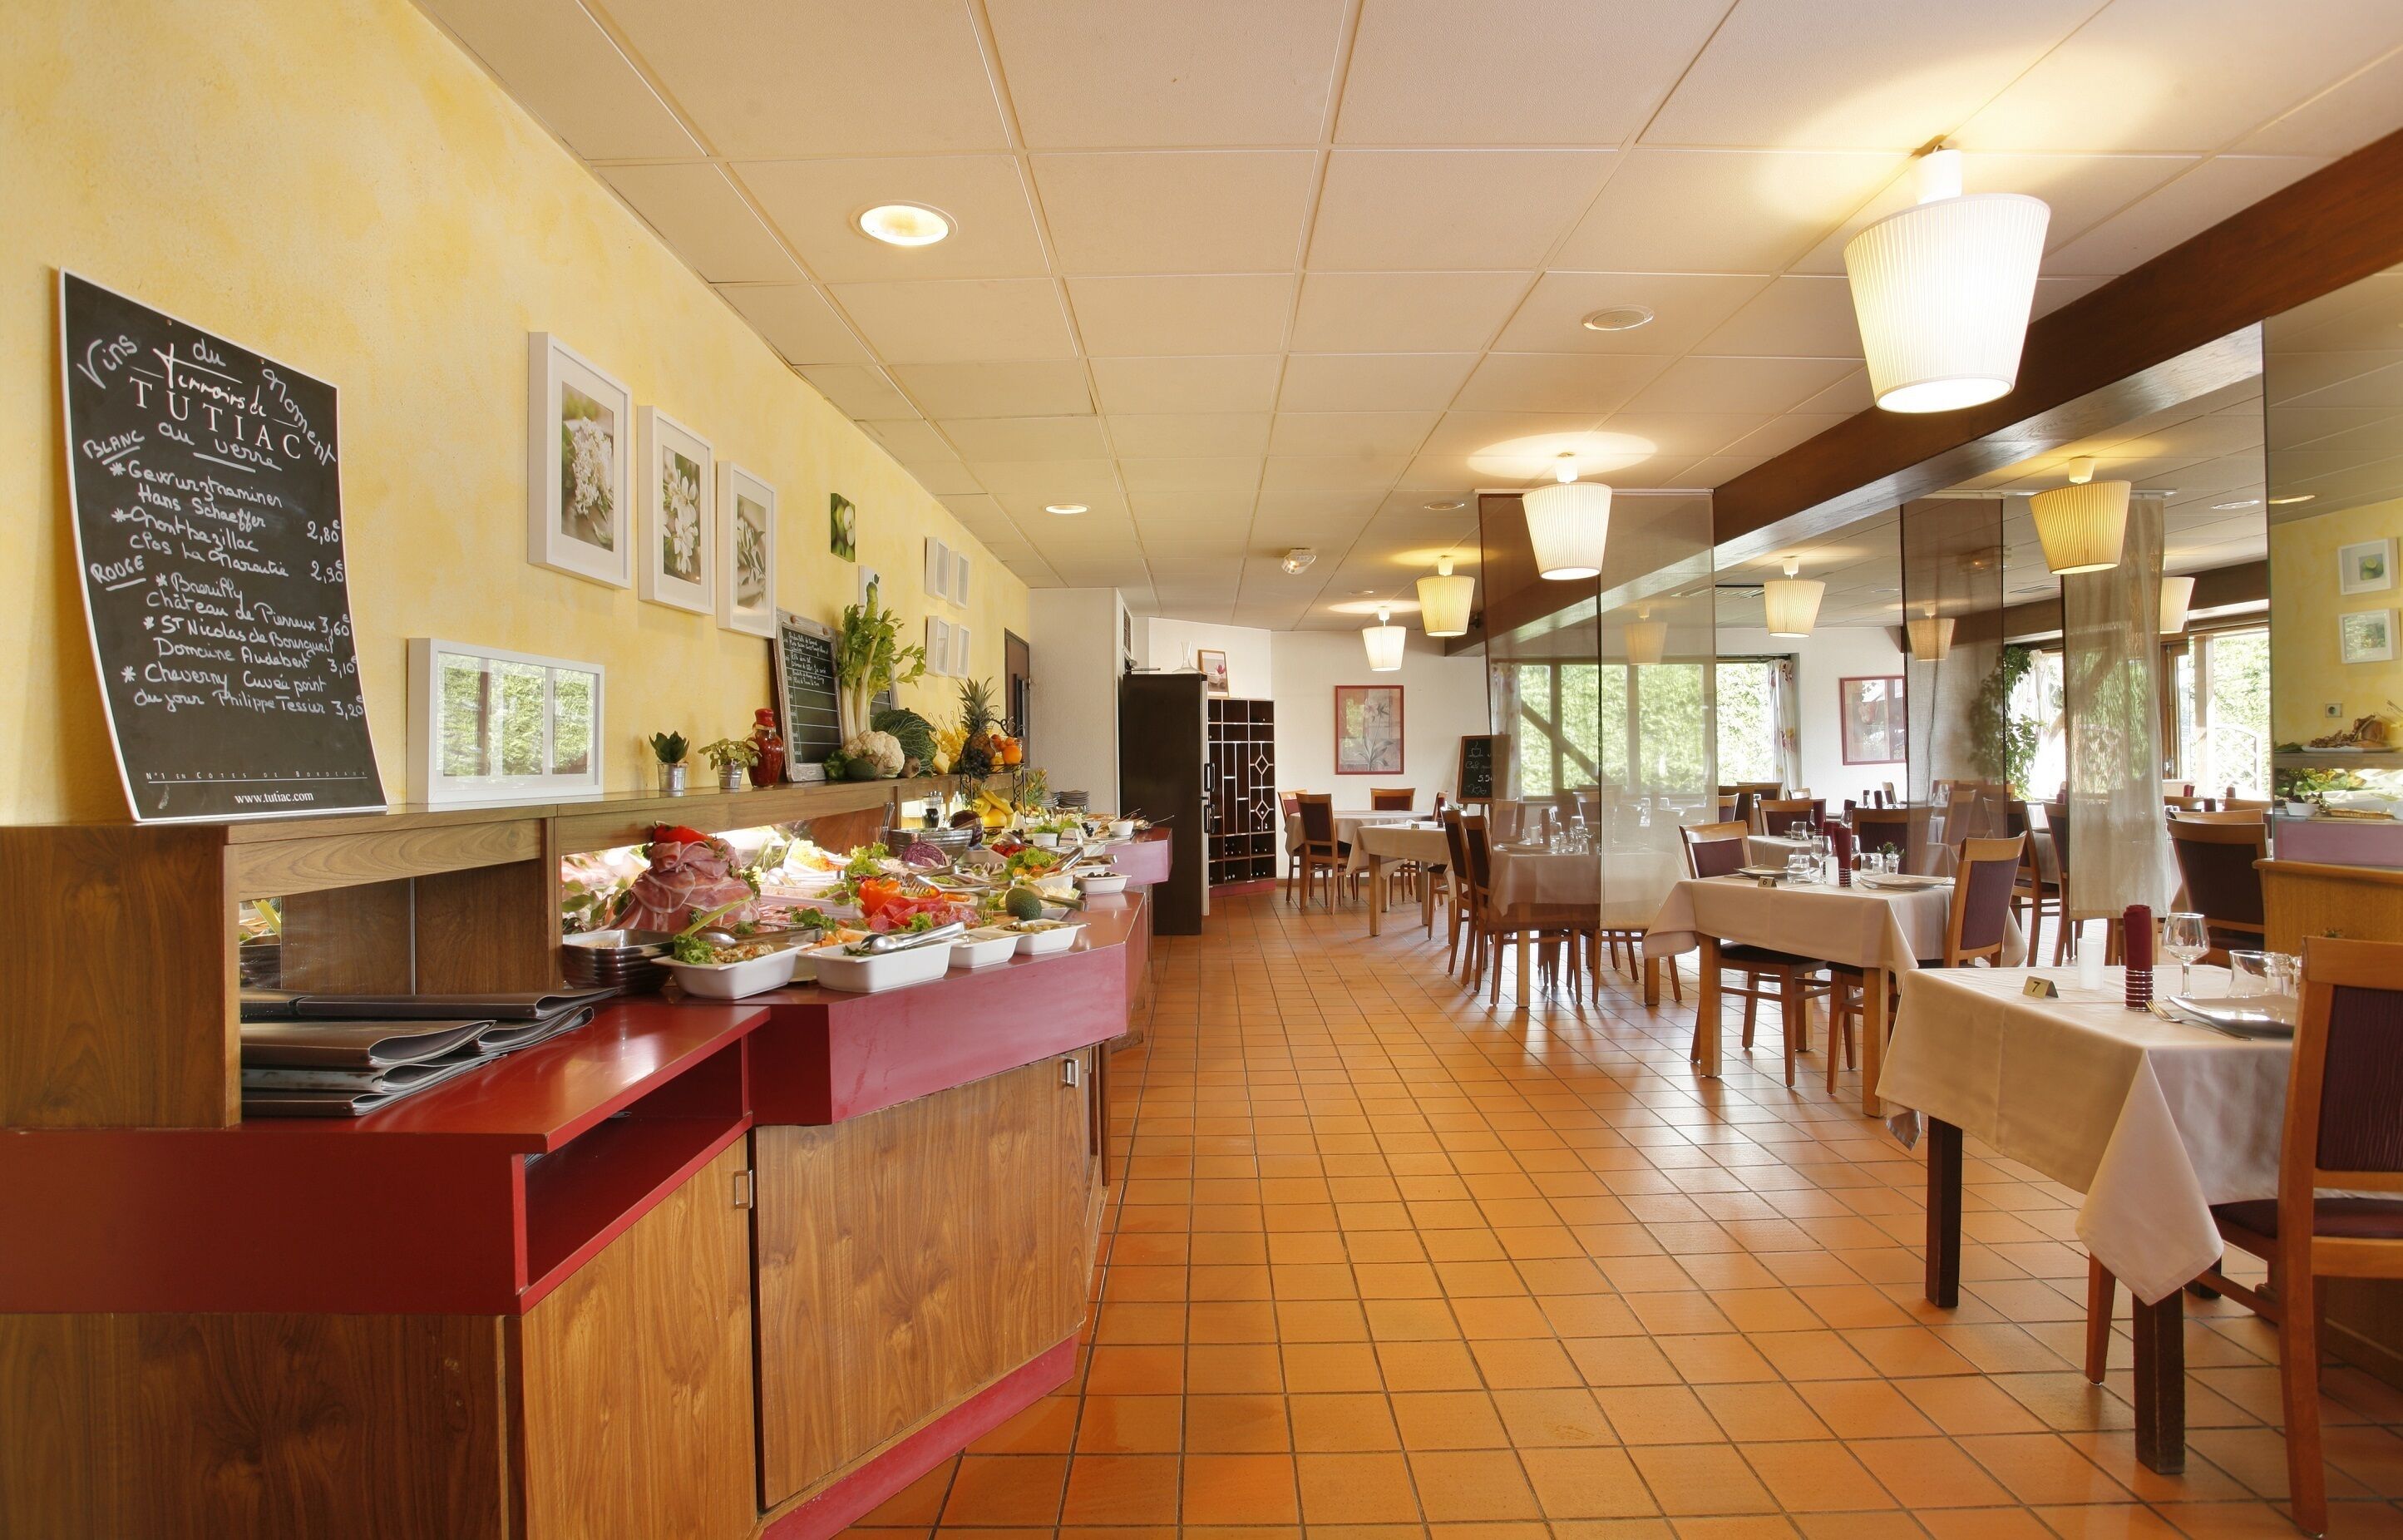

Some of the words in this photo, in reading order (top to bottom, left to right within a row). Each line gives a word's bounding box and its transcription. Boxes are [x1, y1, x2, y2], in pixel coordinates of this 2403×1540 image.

[76, 335, 138, 389] Vins
[193, 338, 226, 367] du
[262, 368, 337, 466] Moment
[129, 377, 301, 459] TUTIAC
[83, 430, 145, 459] BLANC
[158, 422, 195, 446] au
[215, 439, 283, 471] verre
[138, 482, 181, 511] Hans
[90, 555, 145, 584] ROUGE
[188, 619, 247, 642] Nicolas
[249, 627, 268, 644] de
[153, 637, 235, 662] Domaine
[234, 791, 314, 805] www.tutiac.com
[2031, 980, 2041, 993] 7
